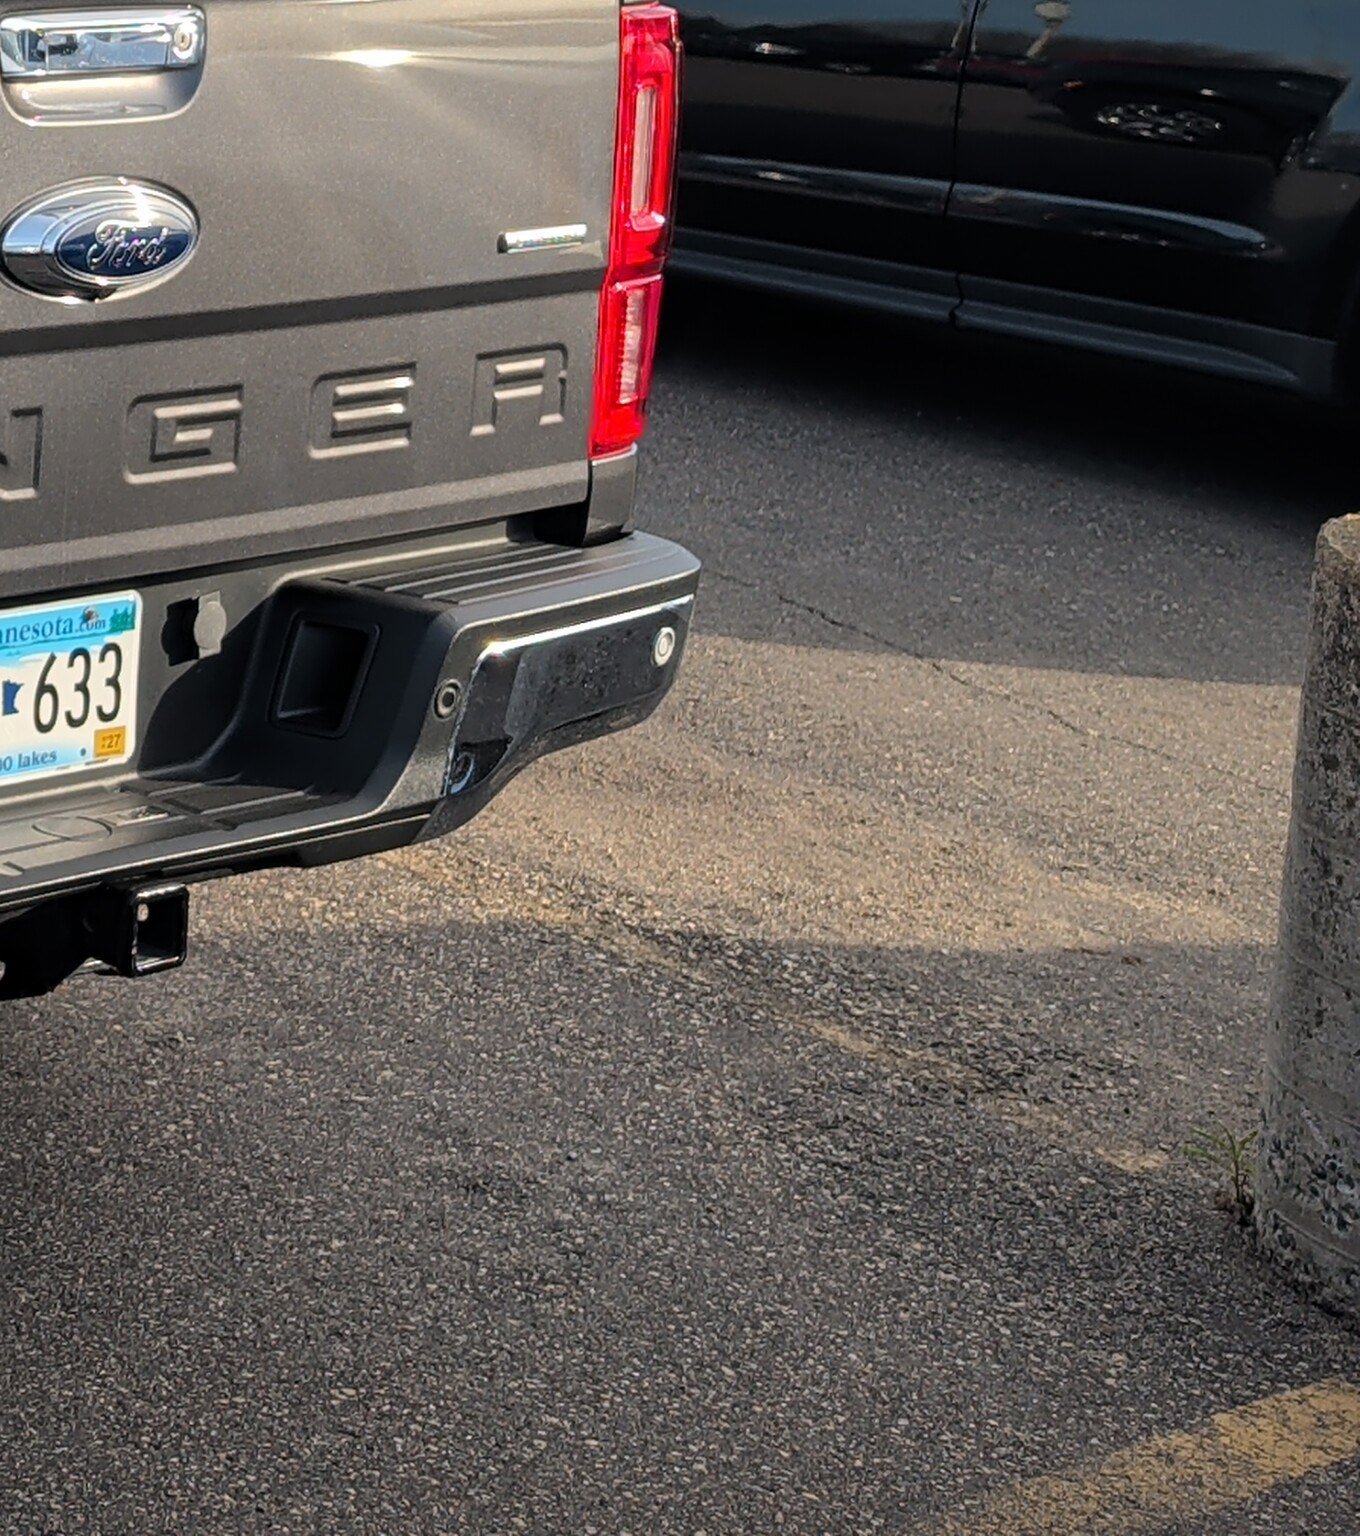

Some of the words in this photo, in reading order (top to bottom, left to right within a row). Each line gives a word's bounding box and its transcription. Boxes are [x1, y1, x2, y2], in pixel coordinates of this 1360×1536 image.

[86, 219, 169, 271] Ford
[34, 642, 123, 734] 633
[107, 733, 121, 749] 27
[18, 749, 58, 770] lakes
